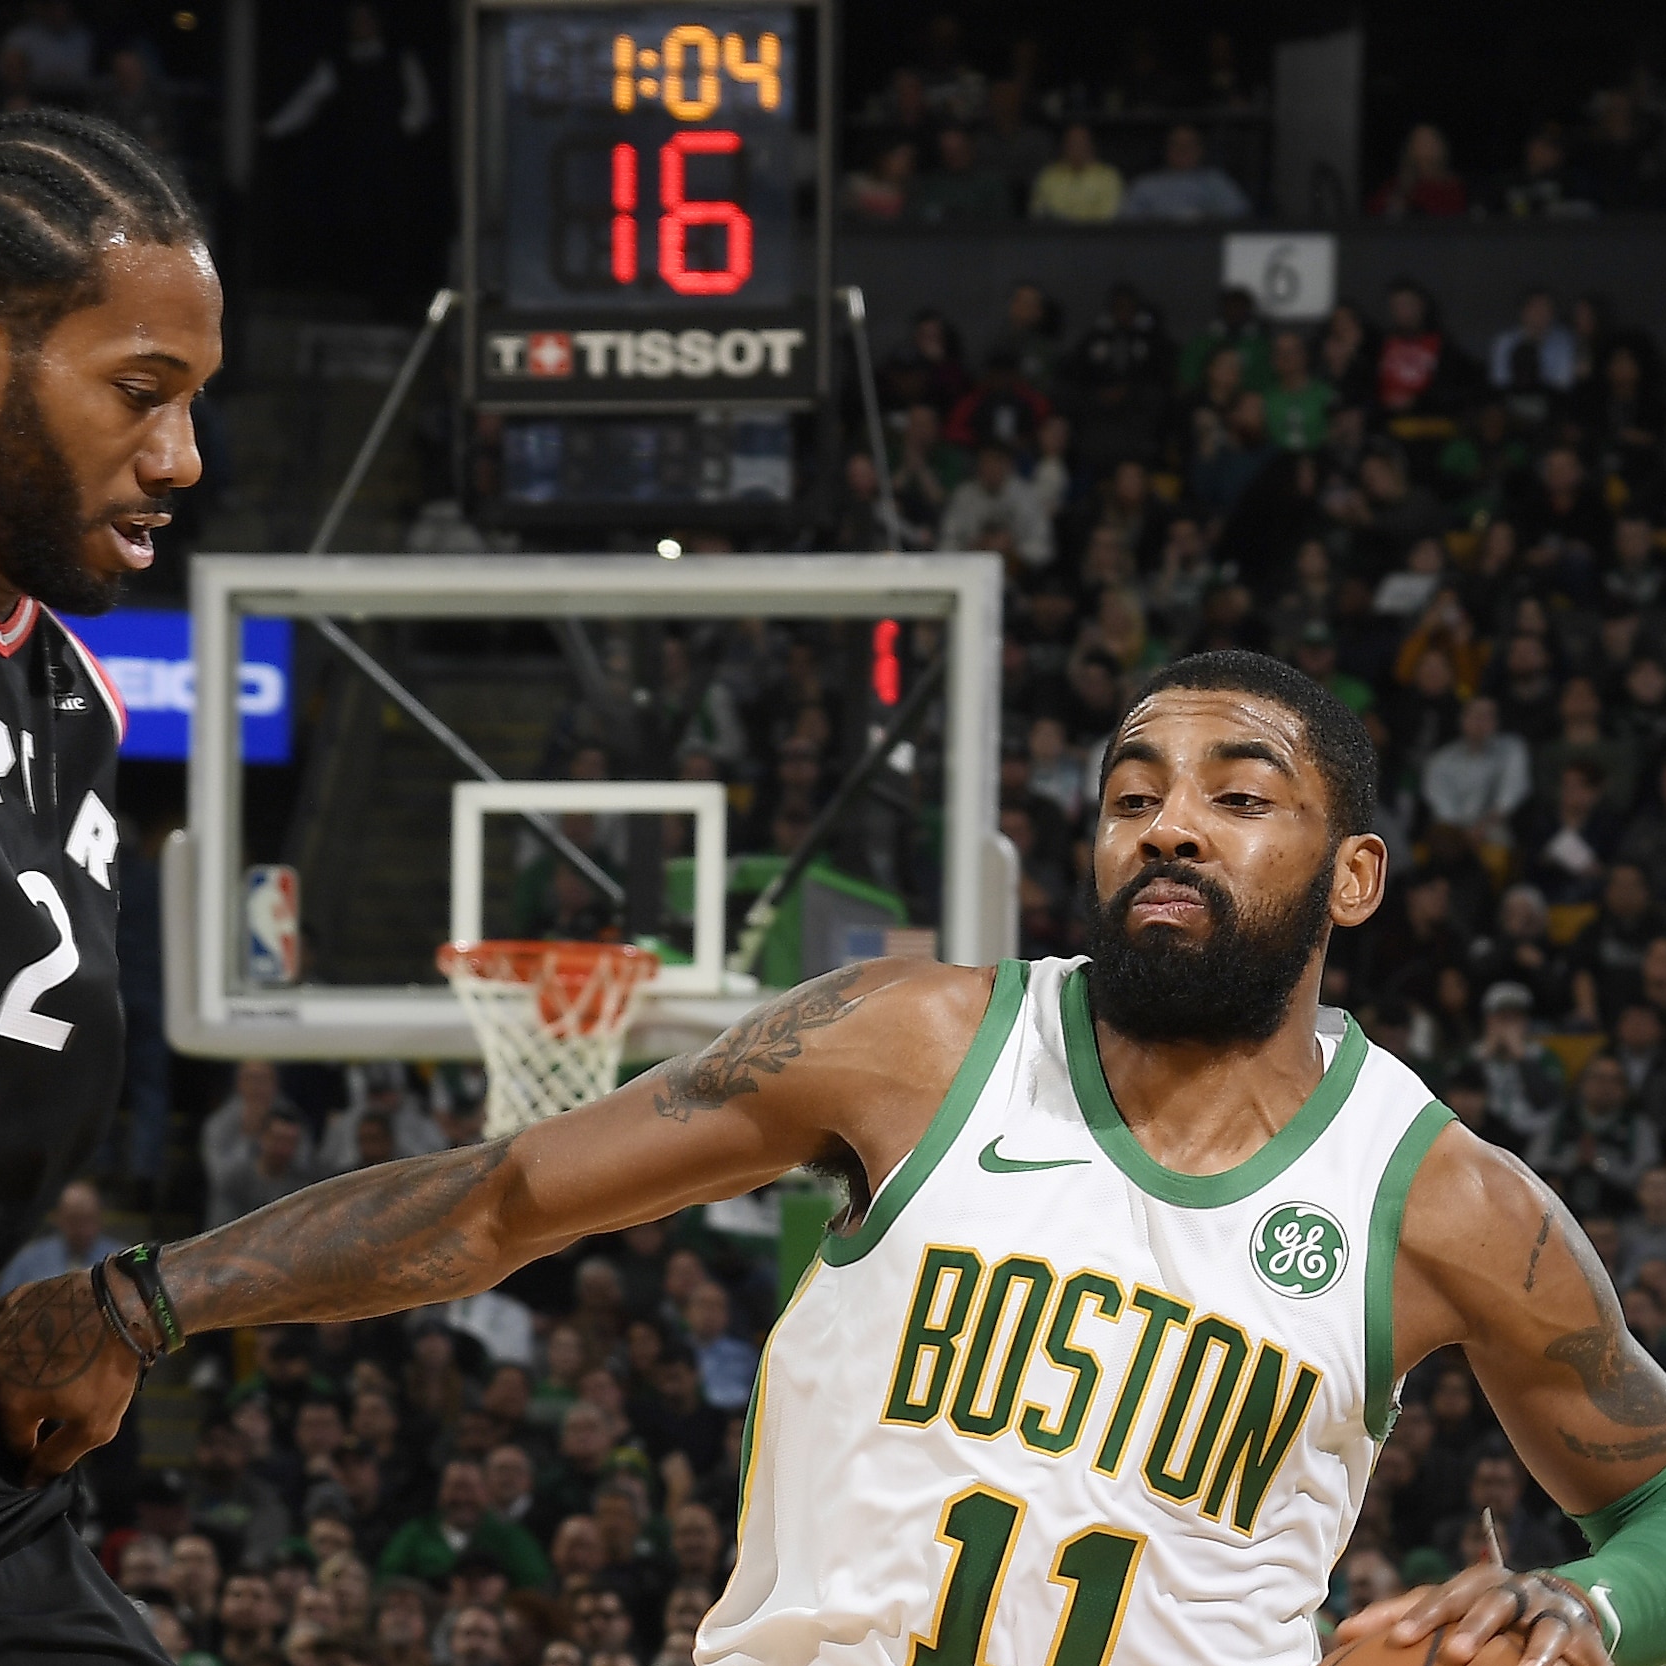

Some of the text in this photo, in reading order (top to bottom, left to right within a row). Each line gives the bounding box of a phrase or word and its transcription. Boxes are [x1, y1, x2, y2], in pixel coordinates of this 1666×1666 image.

[612, 24, 783, 121] 1:04
[611, 130, 753, 296] 16
[1262, 241, 1302, 305] 6
[573, 329, 804, 378] TISSOT
[97, 657, 287, 716] EIO
[879, 1242, 1324, 1539] BOSTON
